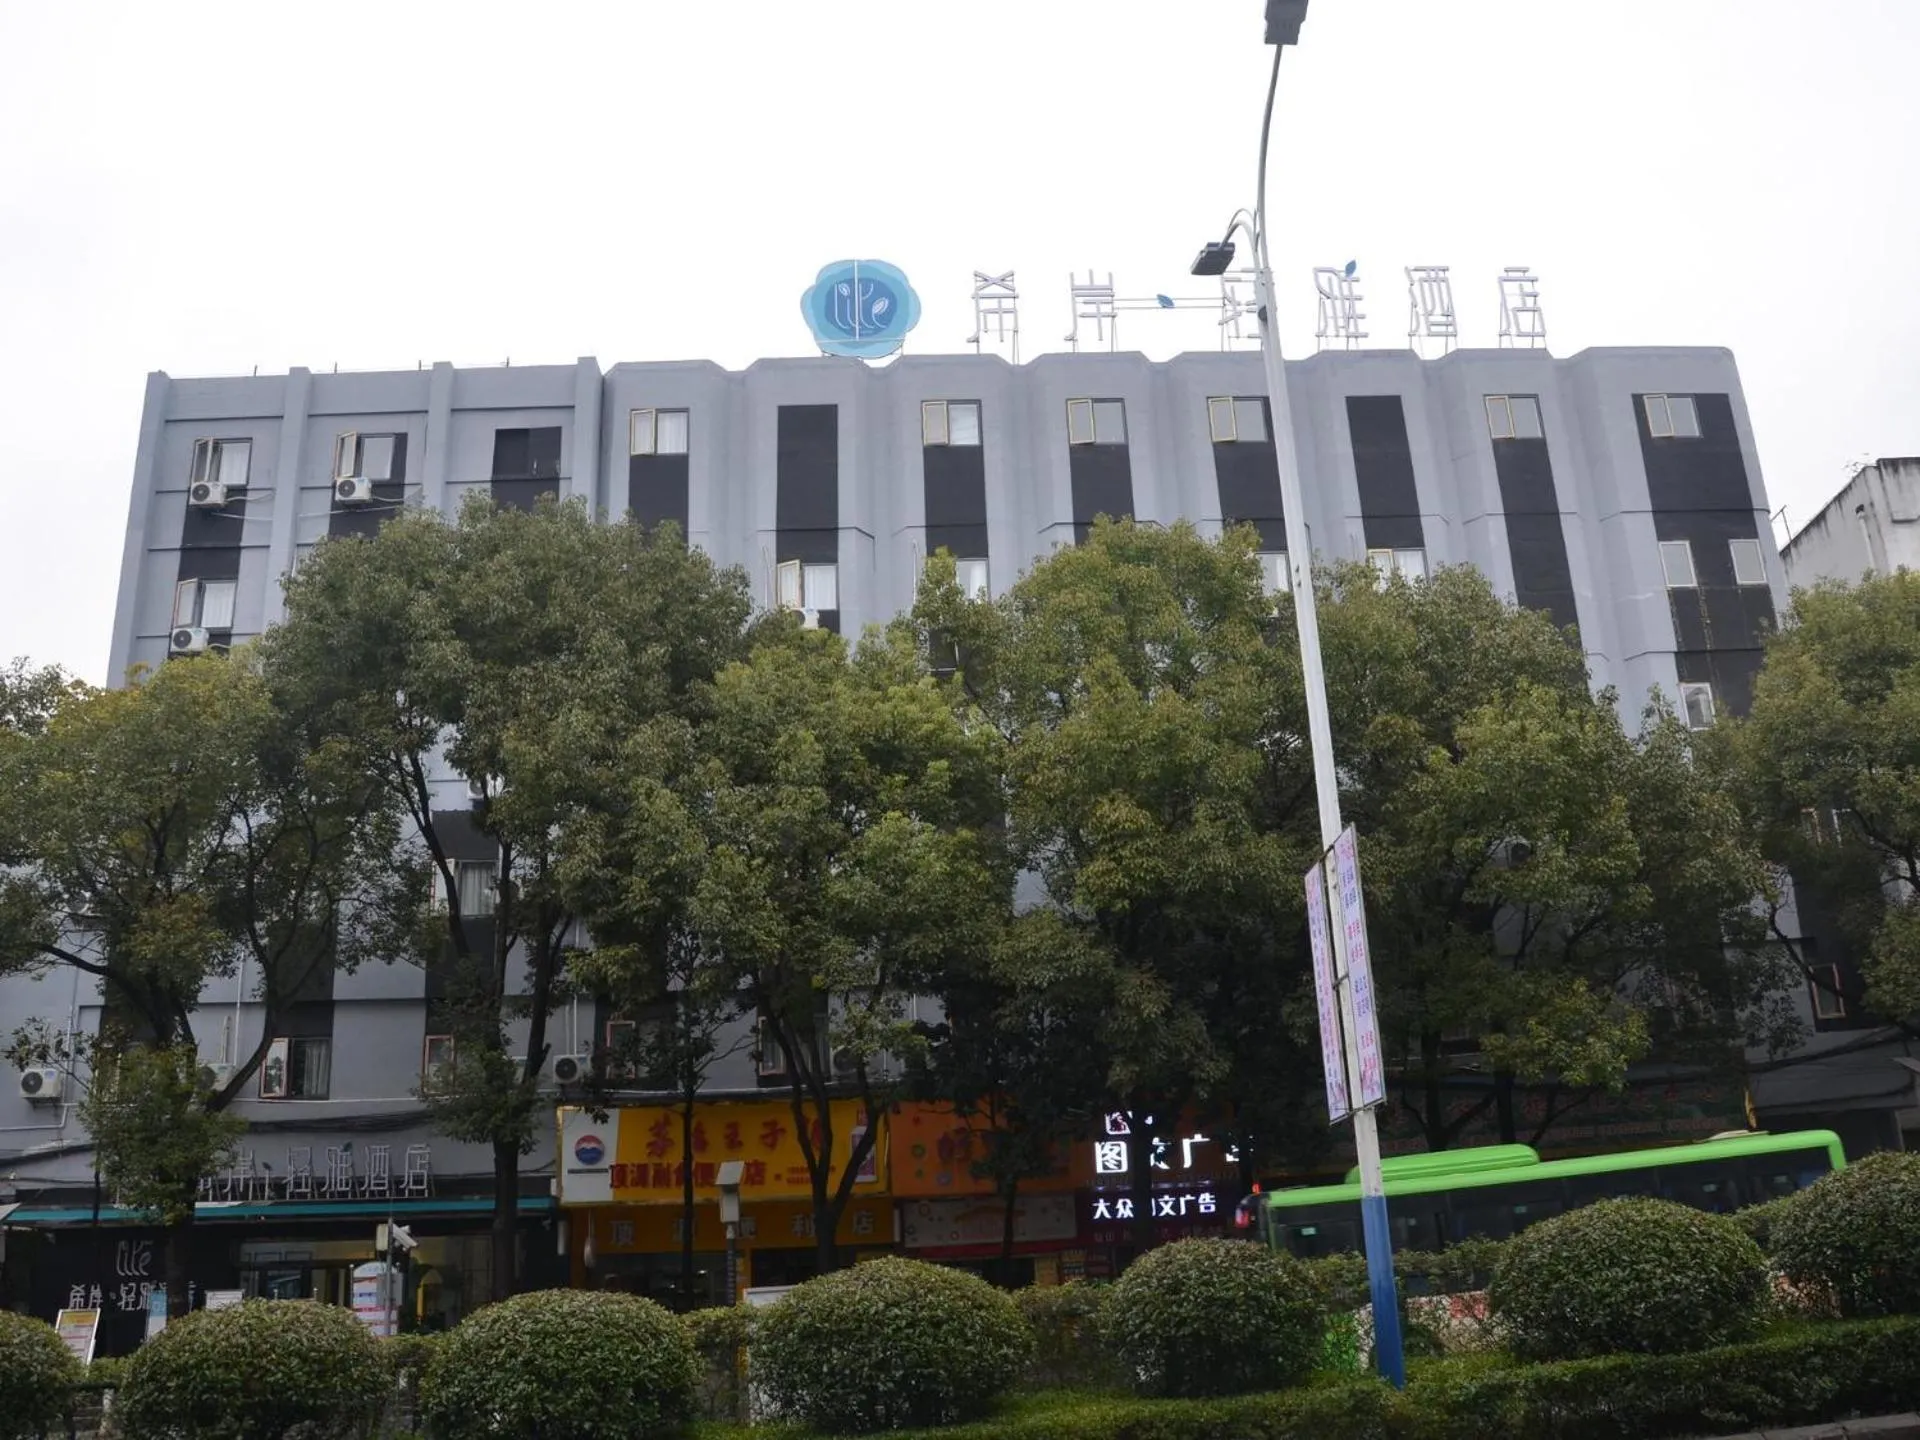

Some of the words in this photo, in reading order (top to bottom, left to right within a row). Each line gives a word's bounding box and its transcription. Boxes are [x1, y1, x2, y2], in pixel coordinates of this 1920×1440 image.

[1092, 1191, 1217, 1221] 大众文广告
